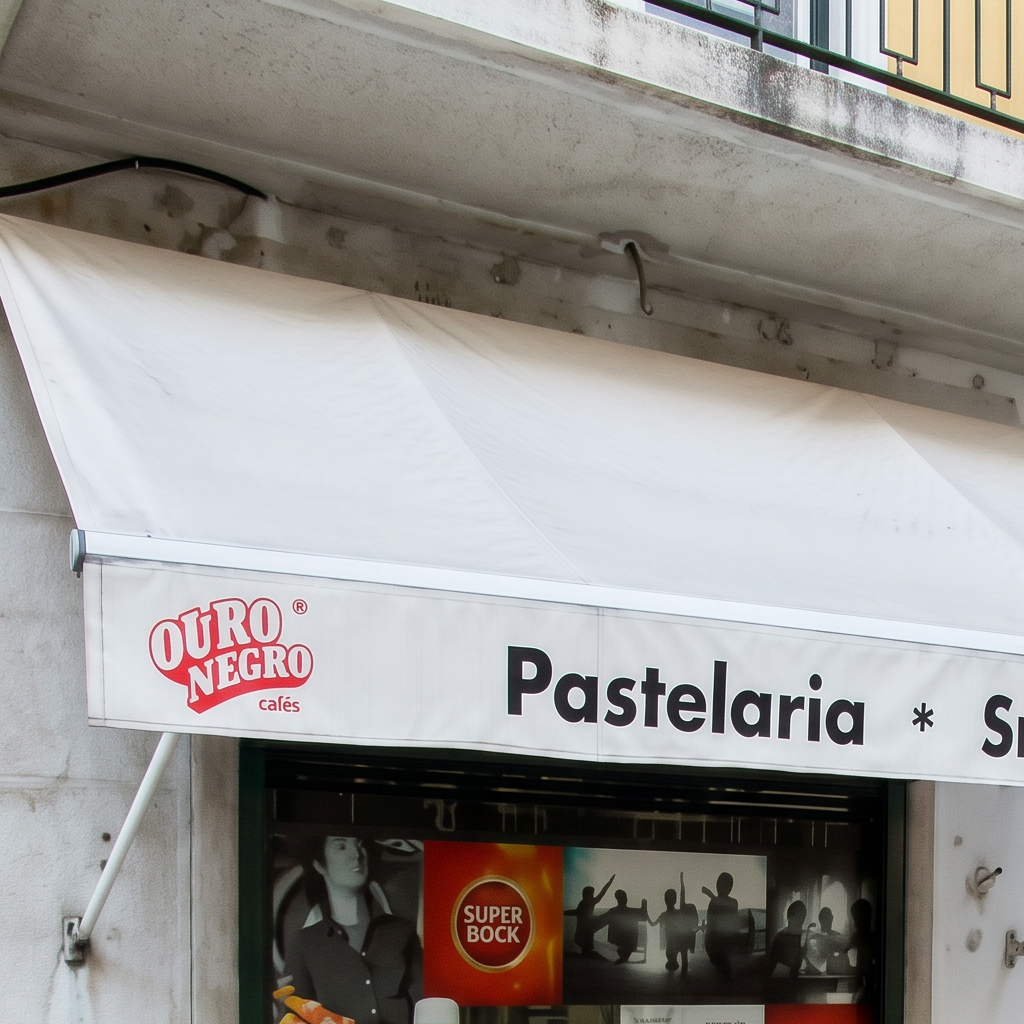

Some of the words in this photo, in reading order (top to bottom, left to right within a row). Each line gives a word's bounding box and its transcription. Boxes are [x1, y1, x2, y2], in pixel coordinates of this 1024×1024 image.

[149, 597, 282, 671] OURO
[188, 644, 314, 704] NEGRO
[258, 695, 301, 713] cafés
[507, 645, 865, 746] Pastelaria
[463, 904, 524, 924] SUPER
[466, 925, 521, 944] BOCK
